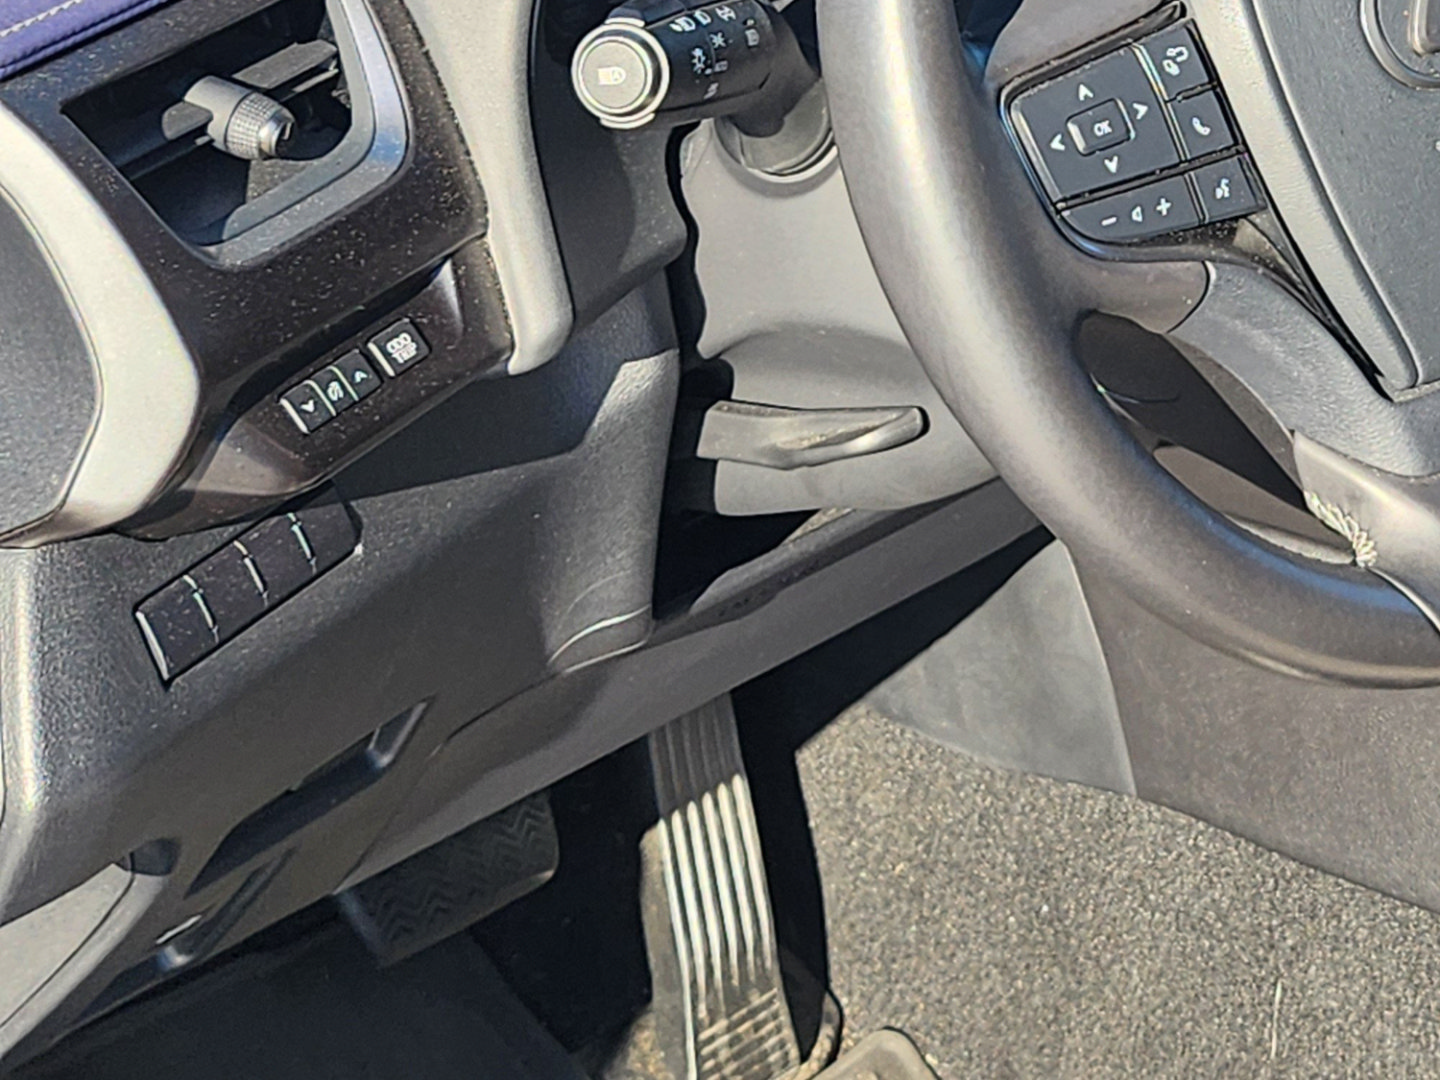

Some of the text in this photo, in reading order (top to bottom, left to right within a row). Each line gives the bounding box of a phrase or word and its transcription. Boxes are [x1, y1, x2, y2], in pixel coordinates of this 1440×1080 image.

[1093, 120, 1113, 136] OK
[386, 332, 412, 353] ODO
[391, 342, 417, 364] TRIP
